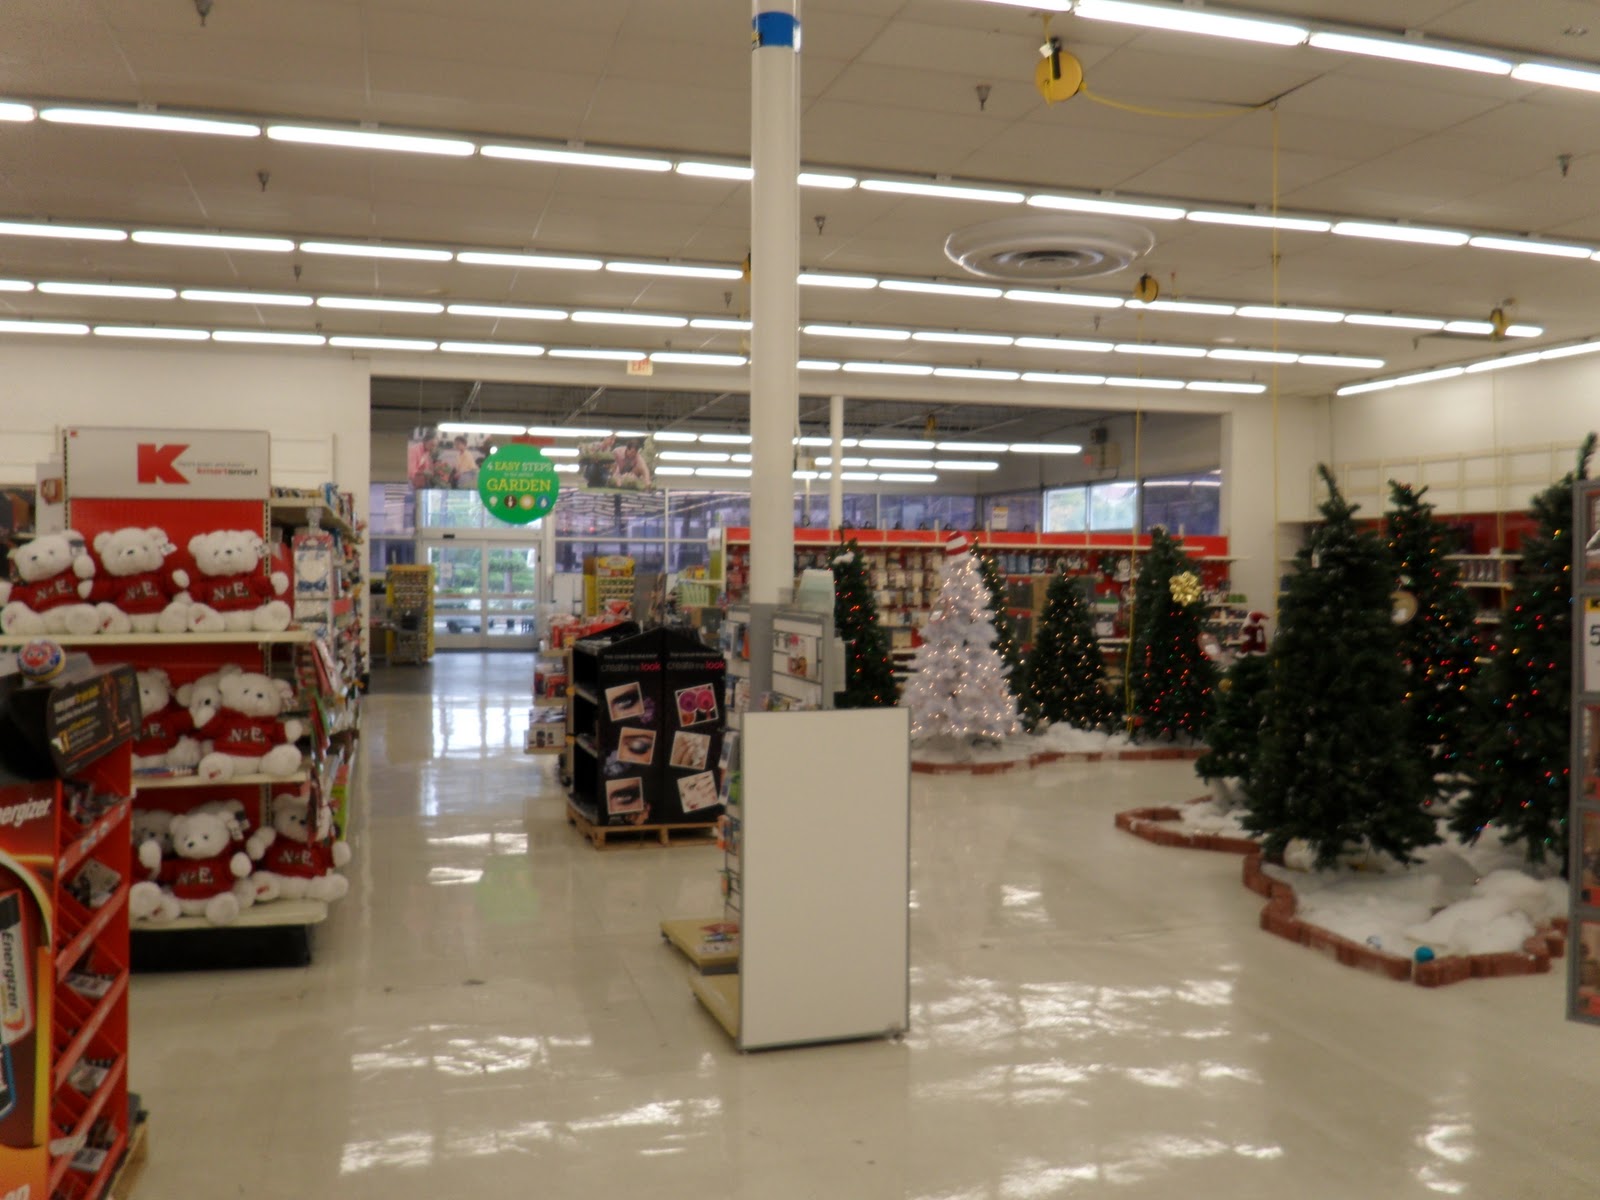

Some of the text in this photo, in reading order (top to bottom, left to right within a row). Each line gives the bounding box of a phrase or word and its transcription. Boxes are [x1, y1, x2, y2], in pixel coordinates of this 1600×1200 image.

[137, 443, 190, 484] K
[495, 461, 520, 471] EASY
[522, 462, 552, 472] STEPS
[486, 478, 551, 492] GARDEN
[640, 662, 661, 671] look
[705, 661, 725, 670] look
[2, 931, 18, 1008] Energizer
